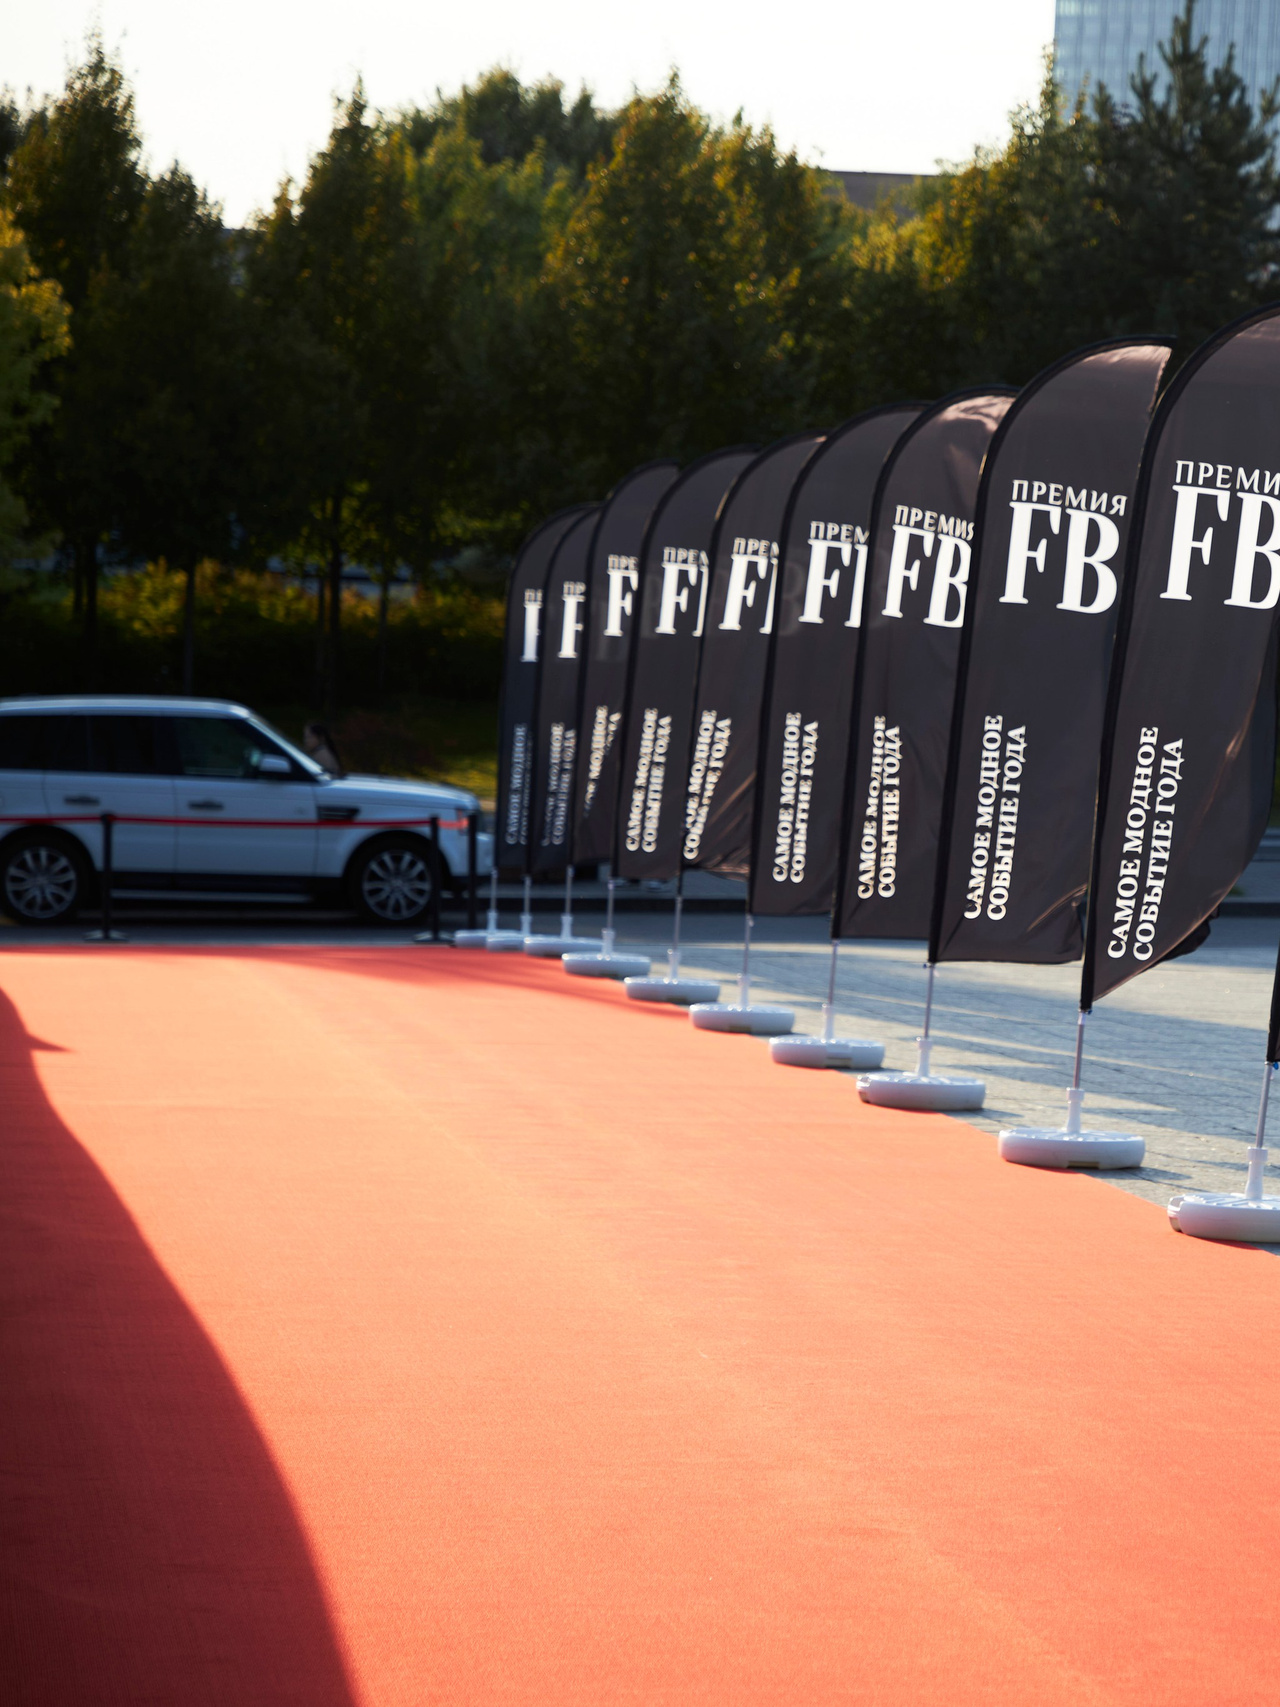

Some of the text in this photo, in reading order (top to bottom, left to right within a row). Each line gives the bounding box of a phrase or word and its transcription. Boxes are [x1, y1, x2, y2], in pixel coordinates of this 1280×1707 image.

[881, 524, 972, 629] FB
[998, 501, 1120, 614] FB
[1012, 479, 1128, 517] ПРЕМИЯ
[772, 711, 802, 883] САМОЕ МОДНОЕ
[789, 720, 819, 883] СОБЫТИЕ ГОДА
[857, 715, 886, 899] САМОЕ МОДНОЕ
[878, 726, 903, 898] СОБЫТИЕ ГОДА
[964, 715, 1003, 919] САМОЕ МОДНОЕ
[987, 725, 1028, 920] СОБЫТИЕ ГОДА
[1108, 726, 1158, 959] САМОЕ МОДНОЕ
[1132, 738, 1185, 961] СОБЫТИЕ ГОДА
